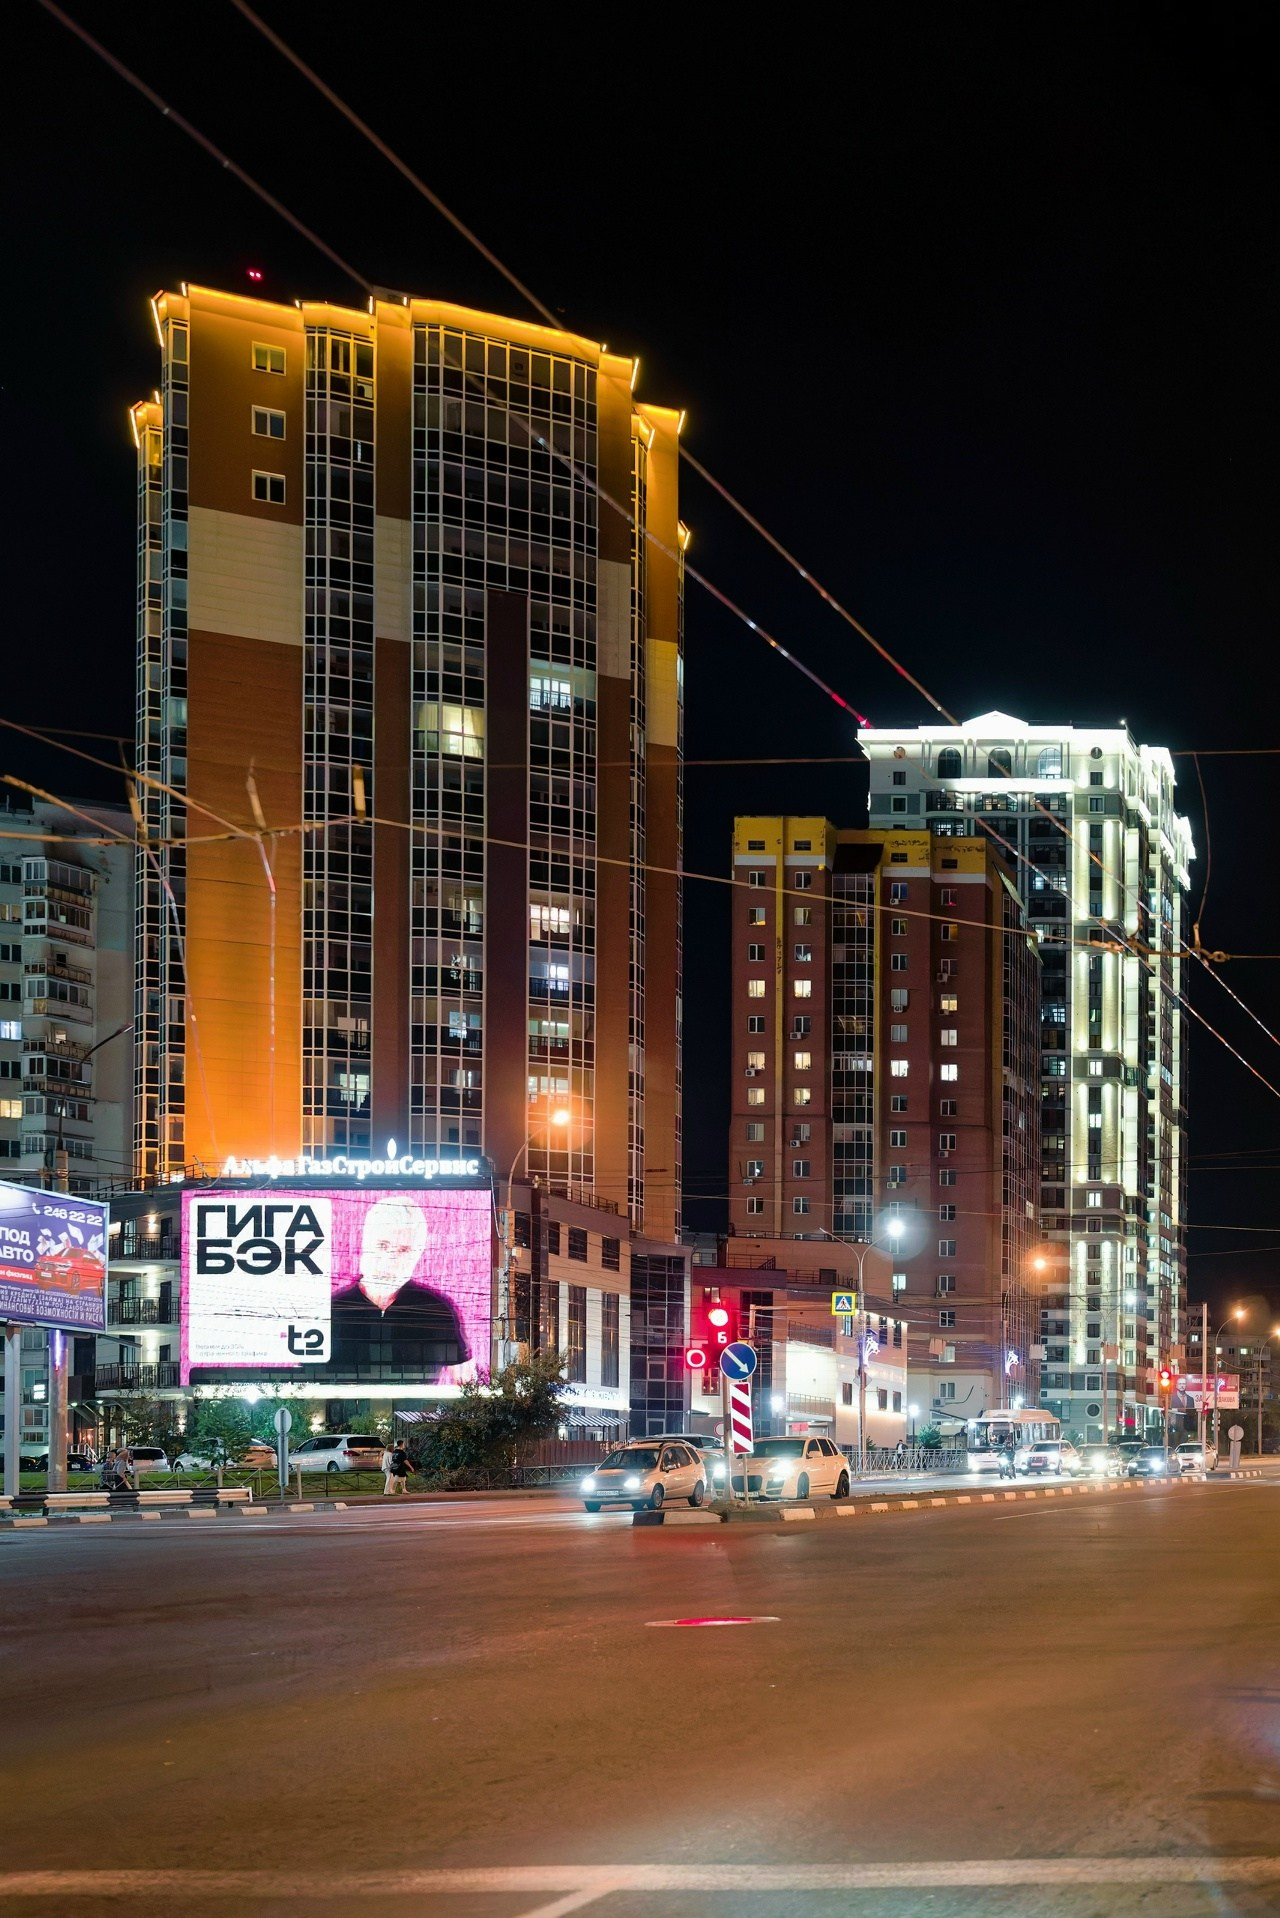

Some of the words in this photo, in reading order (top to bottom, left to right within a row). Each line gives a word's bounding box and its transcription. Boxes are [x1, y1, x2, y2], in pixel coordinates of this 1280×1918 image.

[69, 1210, 86, 1223] 22
[86, 1214, 103, 1227] 22
[197, 1205, 325, 1237] ГИГА
[0, 1226, 31, 1246] ПОД
[197, 1238, 325, 1275] БЭК
[288, 1325, 324, 1355] t2
